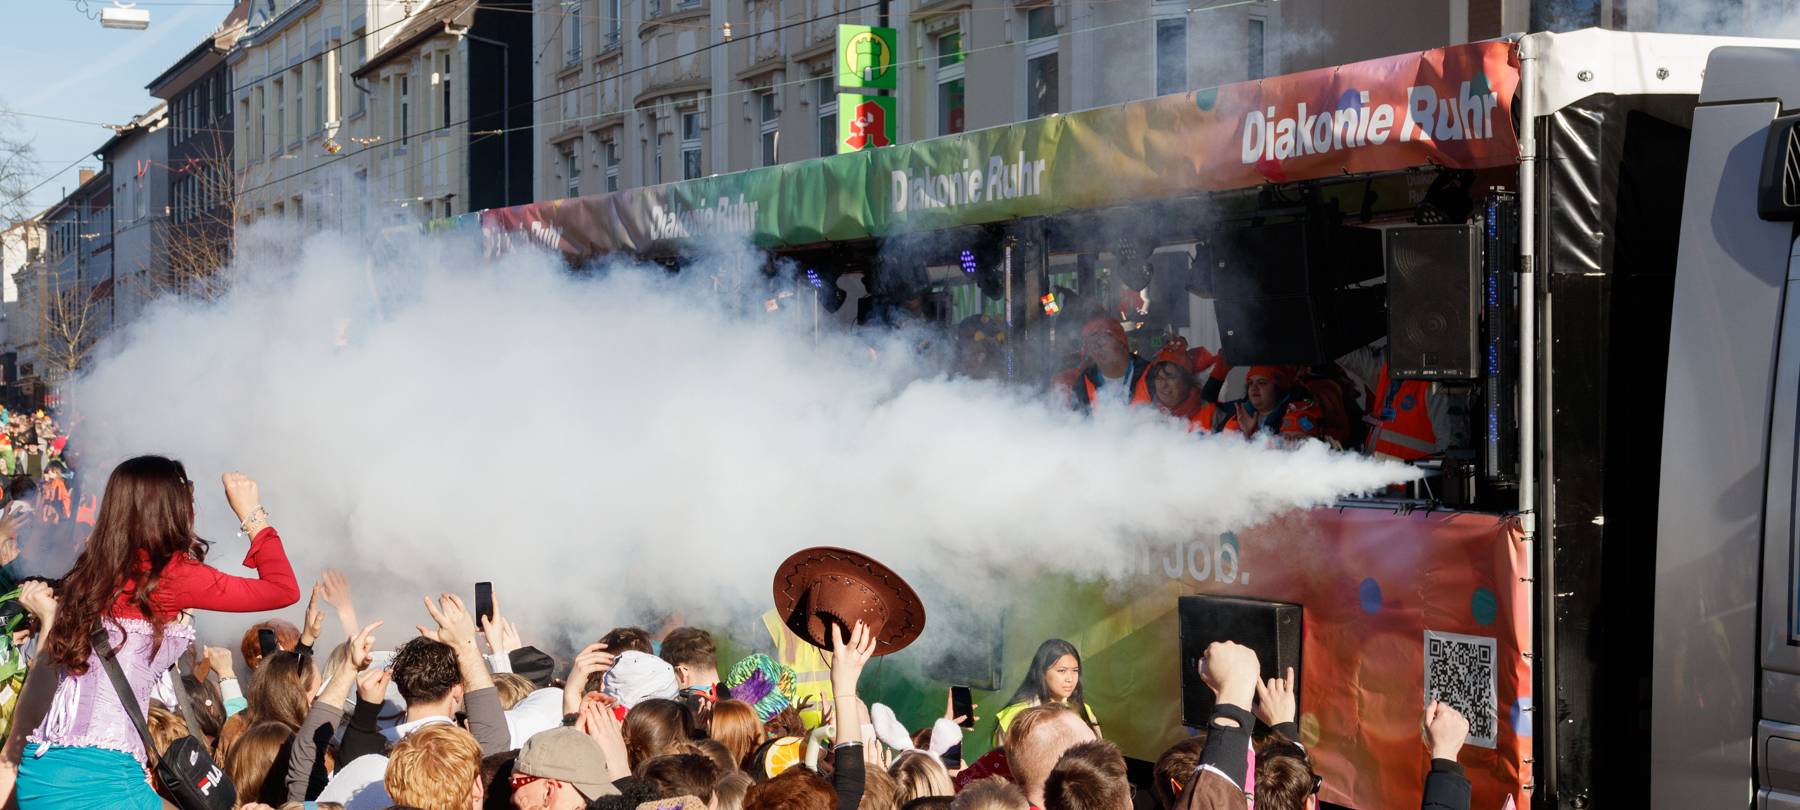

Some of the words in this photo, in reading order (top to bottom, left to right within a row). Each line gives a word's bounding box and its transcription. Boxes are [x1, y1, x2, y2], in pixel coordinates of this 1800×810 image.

[1242, 90, 1394, 164] Diakonie
[1400, 81, 1498, 142] Ruhr
[891, 158, 983, 213] Diakonie
[986, 150, 1045, 201] Ruhr
[716, 193, 759, 236] Ruhr
[1162, 533, 1249, 585] Job.
[197, 764, 223, 796] FILA
